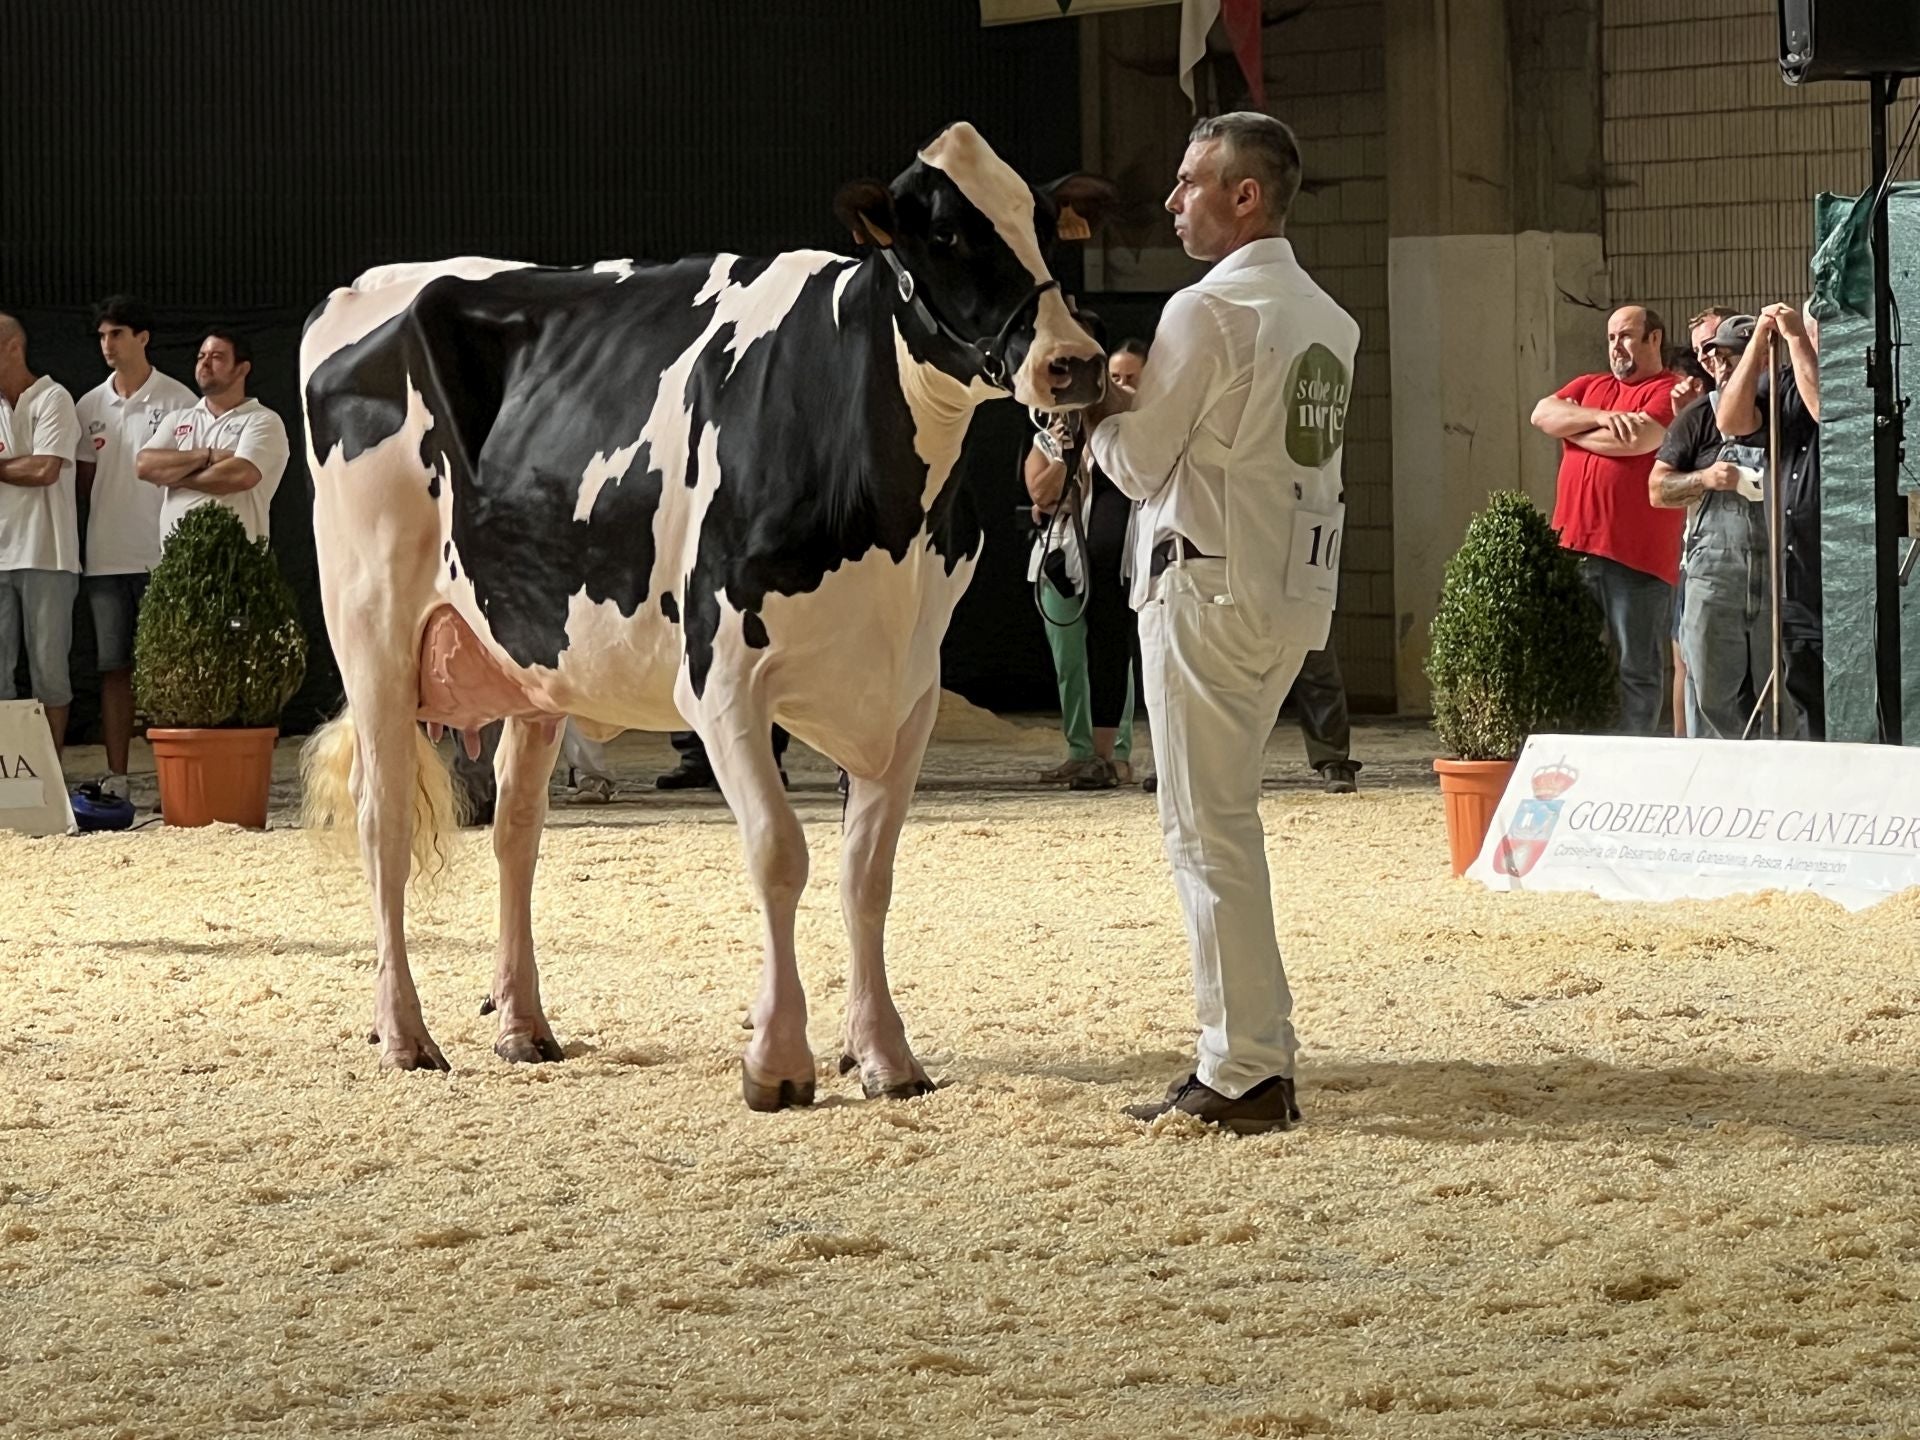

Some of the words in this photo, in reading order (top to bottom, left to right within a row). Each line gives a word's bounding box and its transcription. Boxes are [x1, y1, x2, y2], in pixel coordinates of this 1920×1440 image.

[1305, 524, 1339, 570] 10
[1569, 801, 1724, 837] GOBIERNO
[1725, 807, 1775, 840] DE
